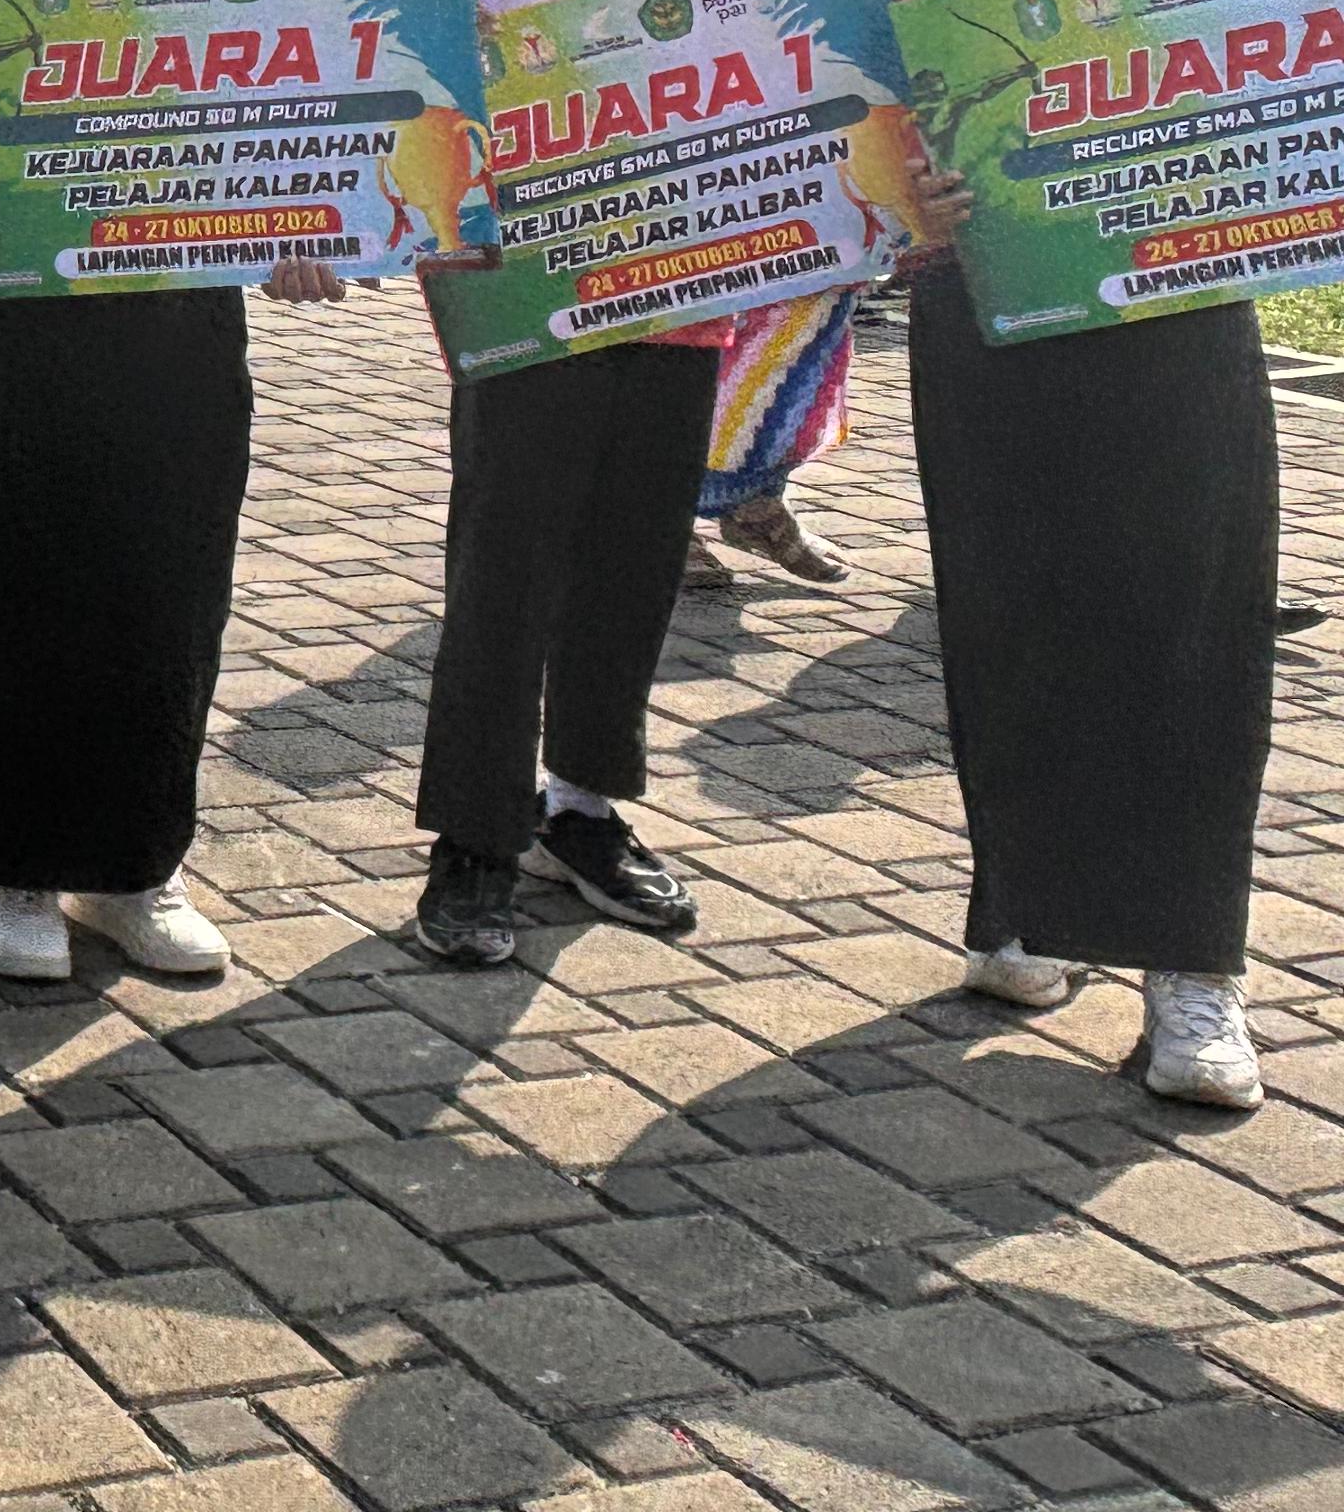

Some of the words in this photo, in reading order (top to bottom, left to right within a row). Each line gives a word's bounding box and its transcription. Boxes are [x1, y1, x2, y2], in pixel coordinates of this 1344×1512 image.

[22, 27, 320, 104] JUARA
[350, 21, 383, 80] 1
[1027, 7, 1344, 136] JUARA
[75, 110, 200, 134] COMPOUND
[268, 101, 337, 121] PUTRI
[492, 52, 764, 173] JUARA
[783, 35, 812, 93] 1
[1072, 121, 1190, 160] RECURVE
[1196, 108, 1255, 134] SMA
[1305, 93, 1326, 111] M
[26, 143, 223, 178] KEJUARAAN
[233, 132, 396, 162] PANAHAN
[515, 162, 614, 202] RECURVE
[712, 132, 730, 150] M
[737, 113, 811, 146] PUTRA
[1047, 142, 1268, 208] KEJUARAAN
[66, 179, 215, 211] PELAJAR
[224, 170, 360, 200] KALBAR
[501, 179, 687, 246] KEJUARAAN
[696, 138, 849, 196] PANAHAN
[1100, 180, 1266, 235] PELAJAR
[103, 223, 128, 242] 24
[146, 220, 168, 239] 27
[174, 214, 267, 237] OKTOBER
[547, 216, 688, 273] PELAJAR
[697, 181, 823, 233] KALBAR
[751, 226, 803, 256] 2024
[1145, 240, 1178, 263] 24
[1194, 231, 1221, 252] 27
[1226, 209, 1335, 245] OKTOBER
[77, 248, 182, 272] LAPANGAN
[1124, 255, 1245, 297] LAPANGAN
[570, 286, 672, 331] LAPANGAN
